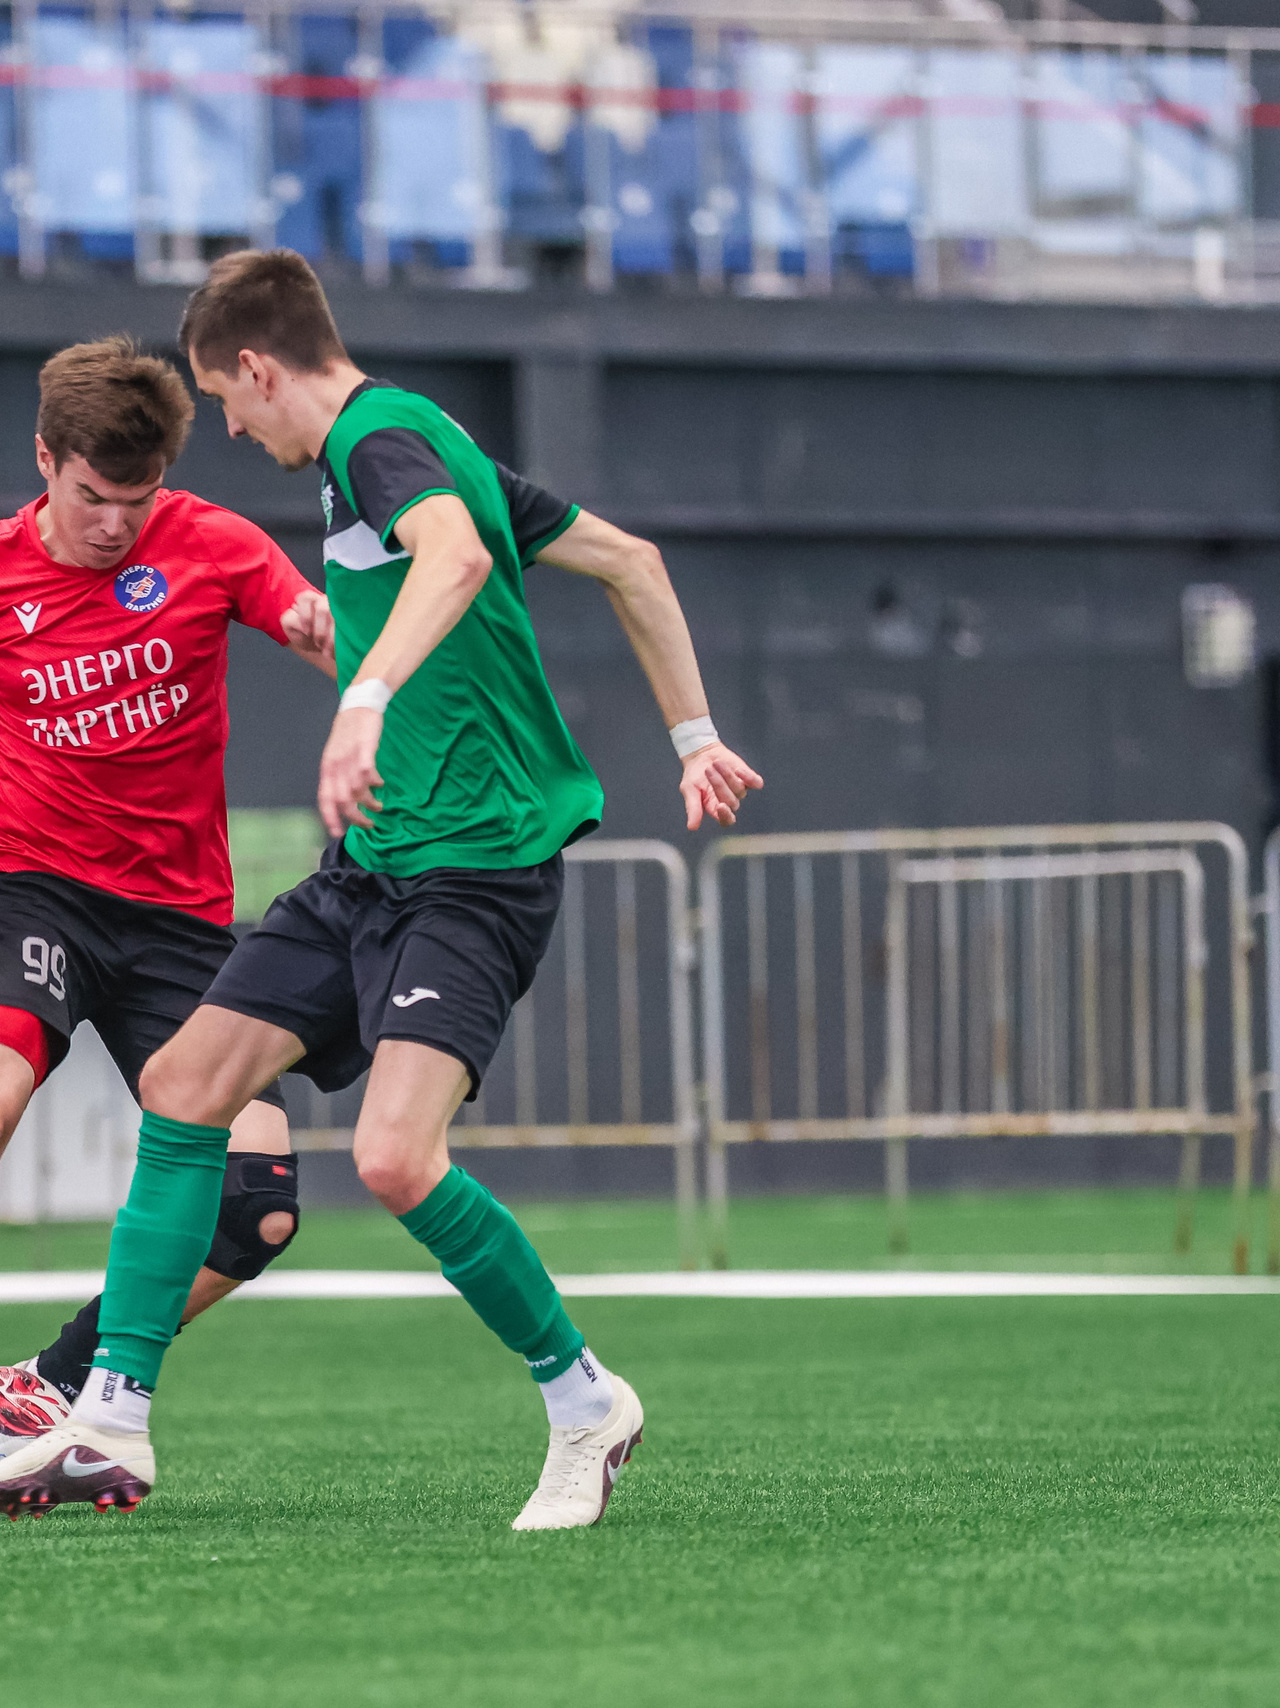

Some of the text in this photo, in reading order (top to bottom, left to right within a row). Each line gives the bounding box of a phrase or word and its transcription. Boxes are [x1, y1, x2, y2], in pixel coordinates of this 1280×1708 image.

[117, 565, 154, 581] ЭНЕРГО
[21, 637, 174, 705] ЭНЕРГО
[26, 683, 190, 747] ПАРТНЁР
[22, 936, 67, 1002] 99
